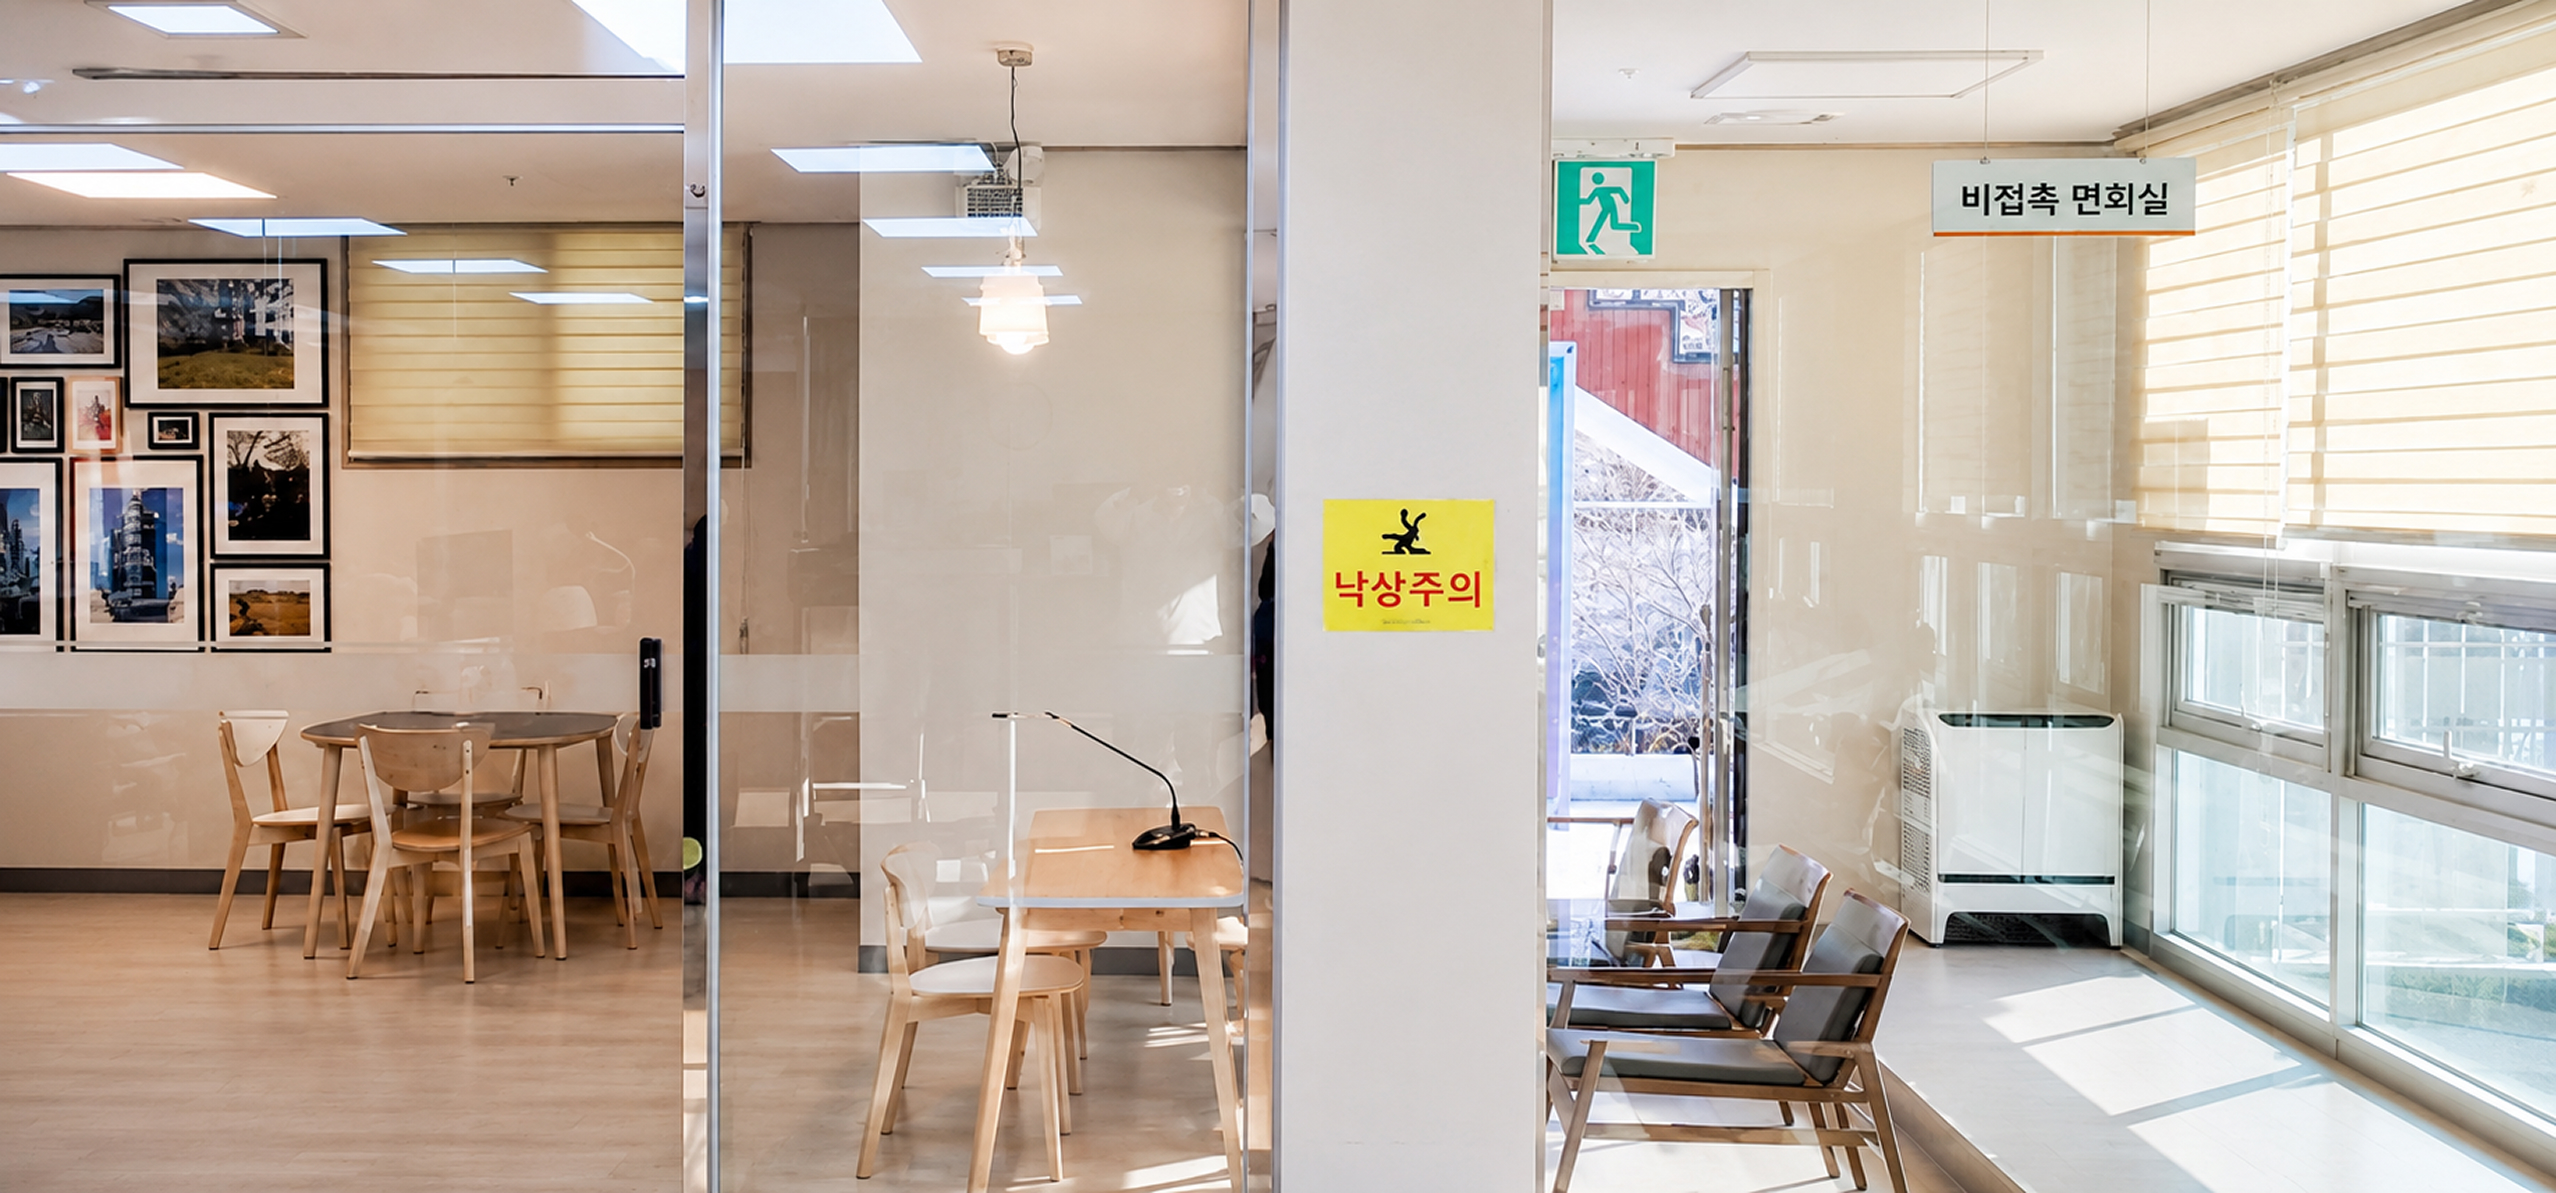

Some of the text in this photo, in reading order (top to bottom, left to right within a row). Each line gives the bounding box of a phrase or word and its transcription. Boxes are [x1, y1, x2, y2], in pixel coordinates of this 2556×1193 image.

[1961, 182, 2169, 217] 비접촉 면회실
[1335, 570, 1481, 608] 낙상주의
